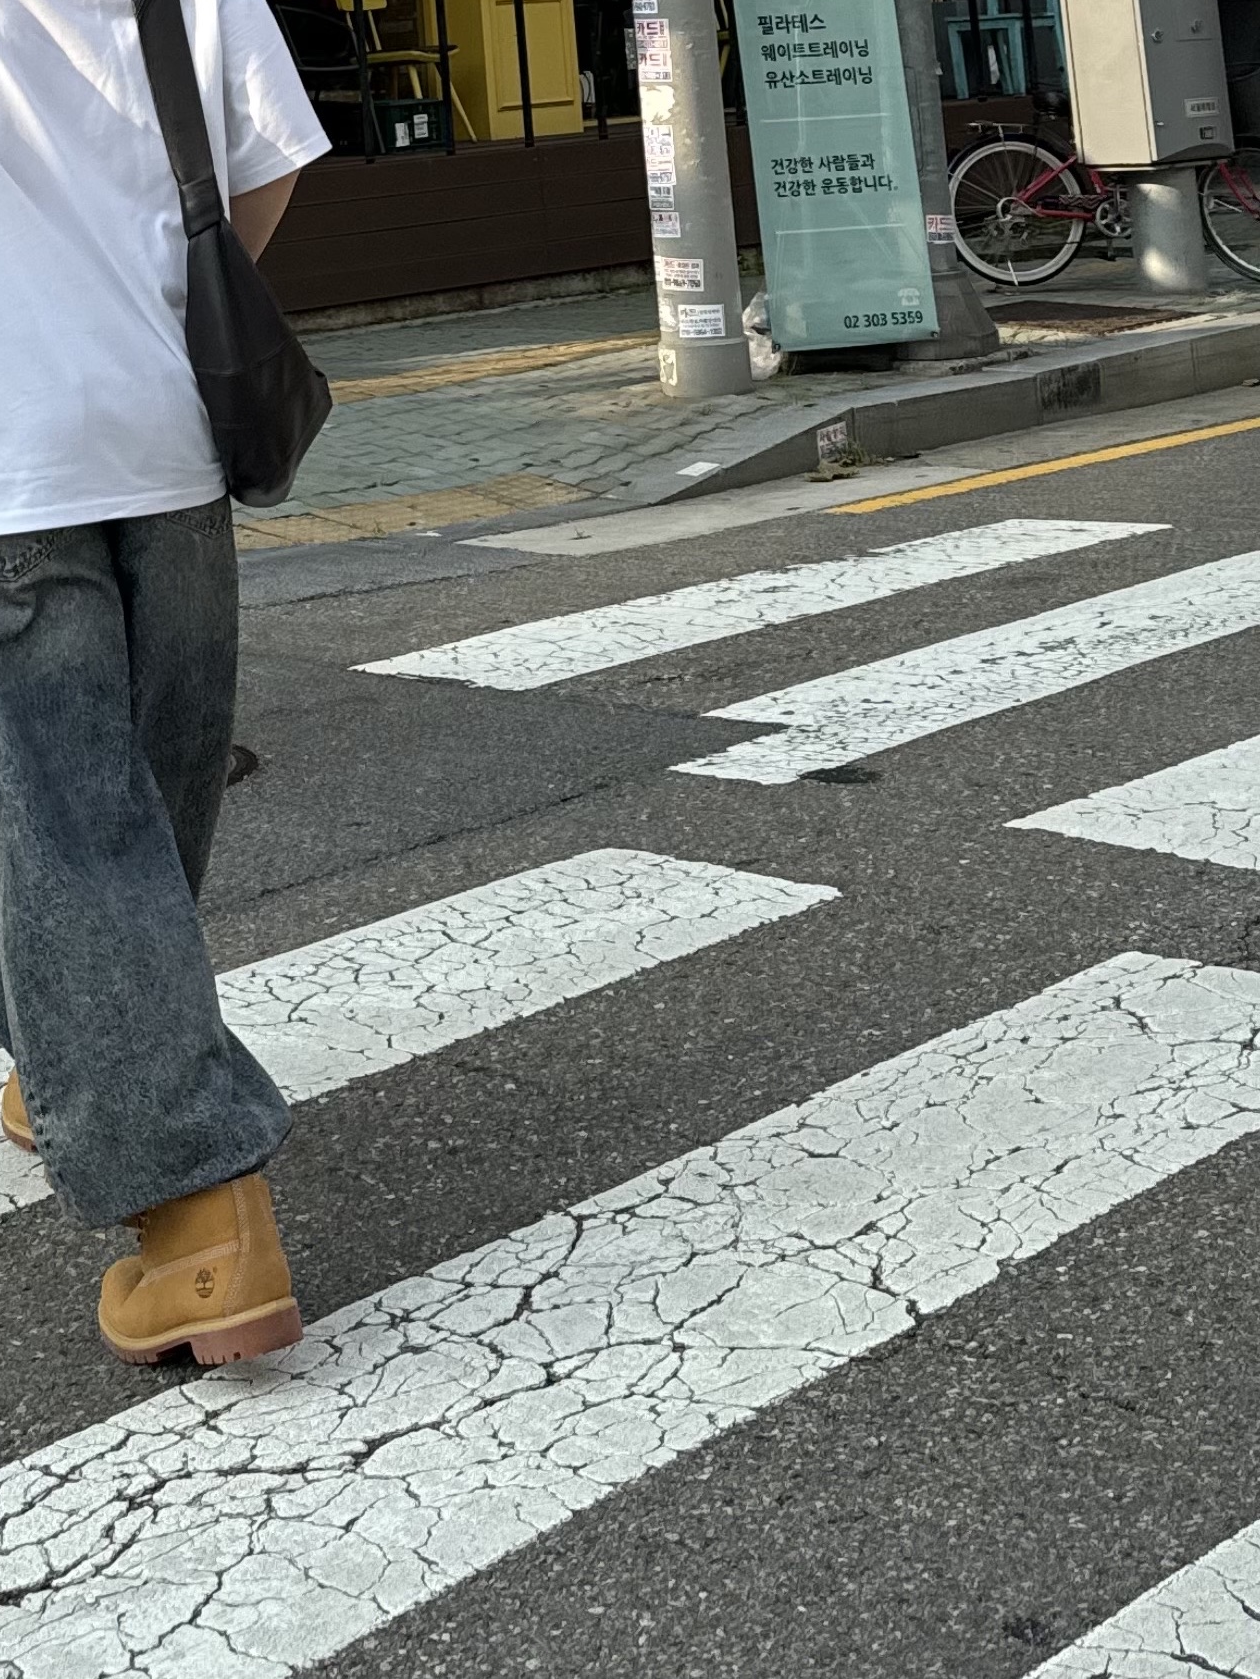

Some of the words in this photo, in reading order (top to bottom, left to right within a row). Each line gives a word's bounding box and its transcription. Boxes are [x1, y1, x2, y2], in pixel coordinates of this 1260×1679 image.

[757, 13, 827, 35] 필라테스
[761, 39, 869, 62] 웨이트트레이닝
[764, 66, 873, 89] 유산소트레이닝
[771, 156, 814, 175] 건강한
[818, 153, 876, 173] 사람들과
[774, 178, 816, 198] 건강한
[821, 174, 899, 195] 운동합니다.
[844, 314, 860, 329] 02
[864, 313, 888, 328] 303
[891, 310, 923, 326] 5359
